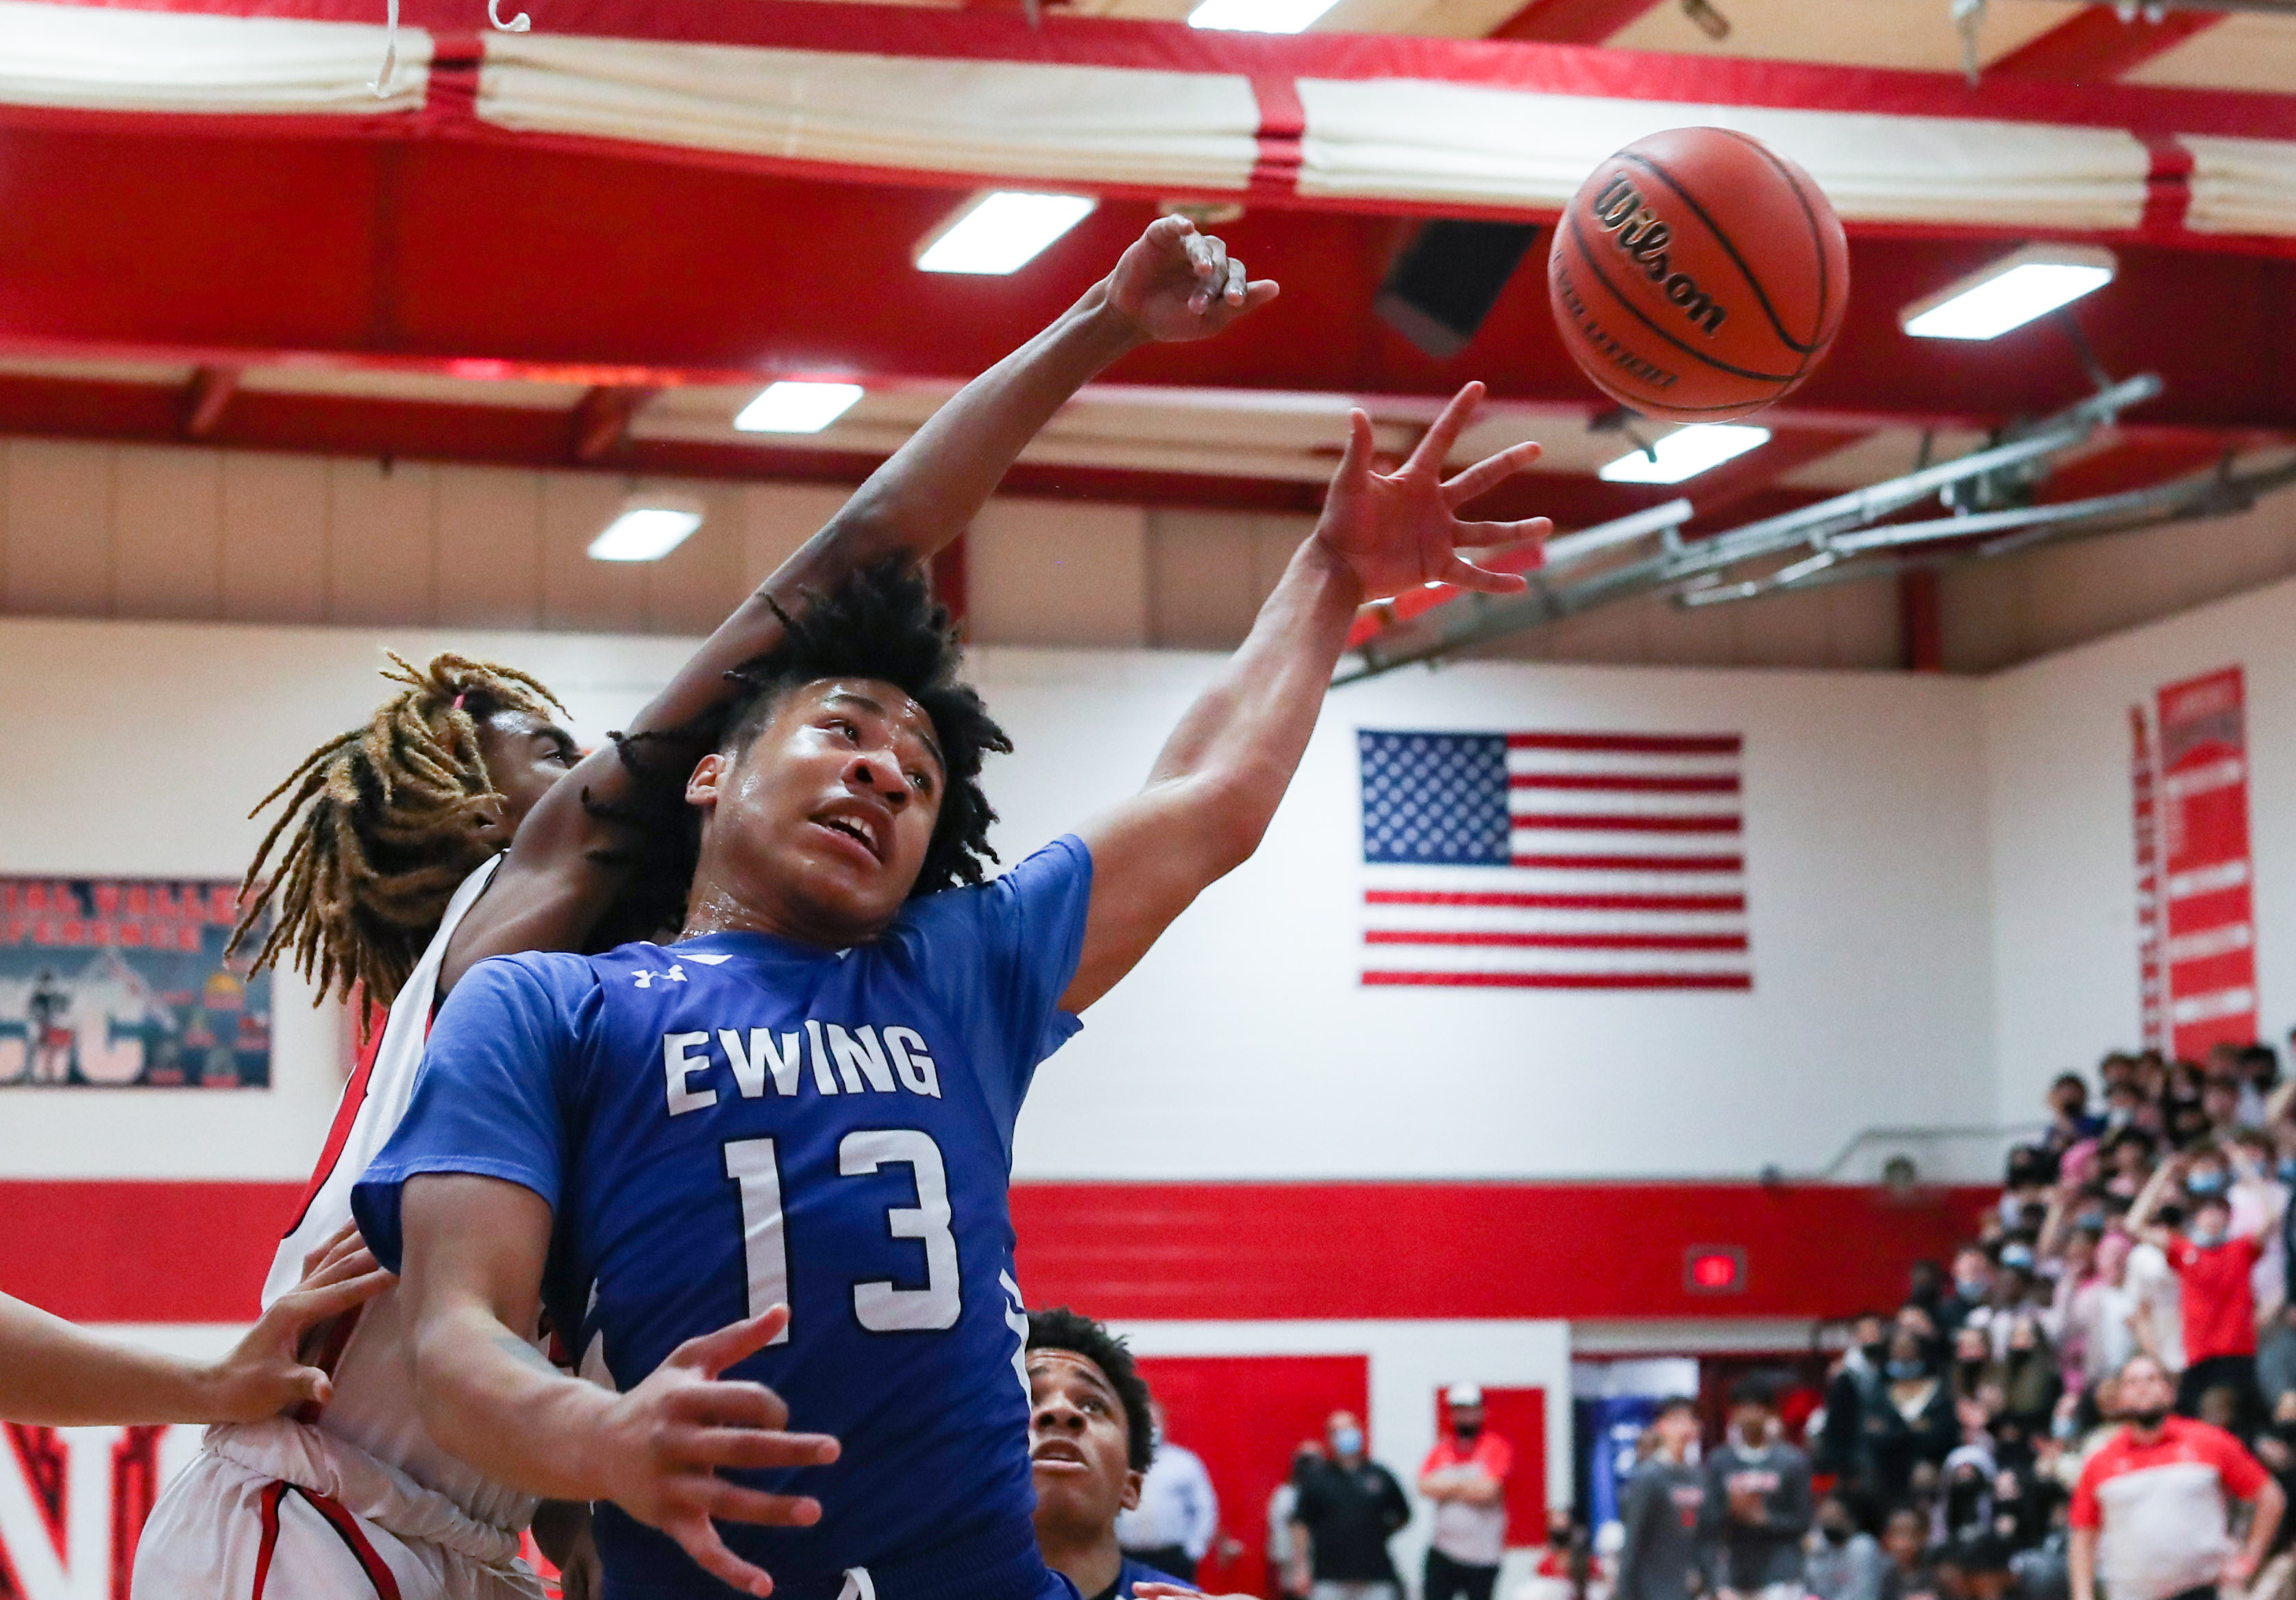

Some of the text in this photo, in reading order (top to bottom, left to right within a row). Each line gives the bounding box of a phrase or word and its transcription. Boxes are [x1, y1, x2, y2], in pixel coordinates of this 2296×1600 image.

[1593, 169, 1727, 337] Wilson
[663, 1019, 942, 1117] EWING
[724, 1128, 962, 1346] 13
